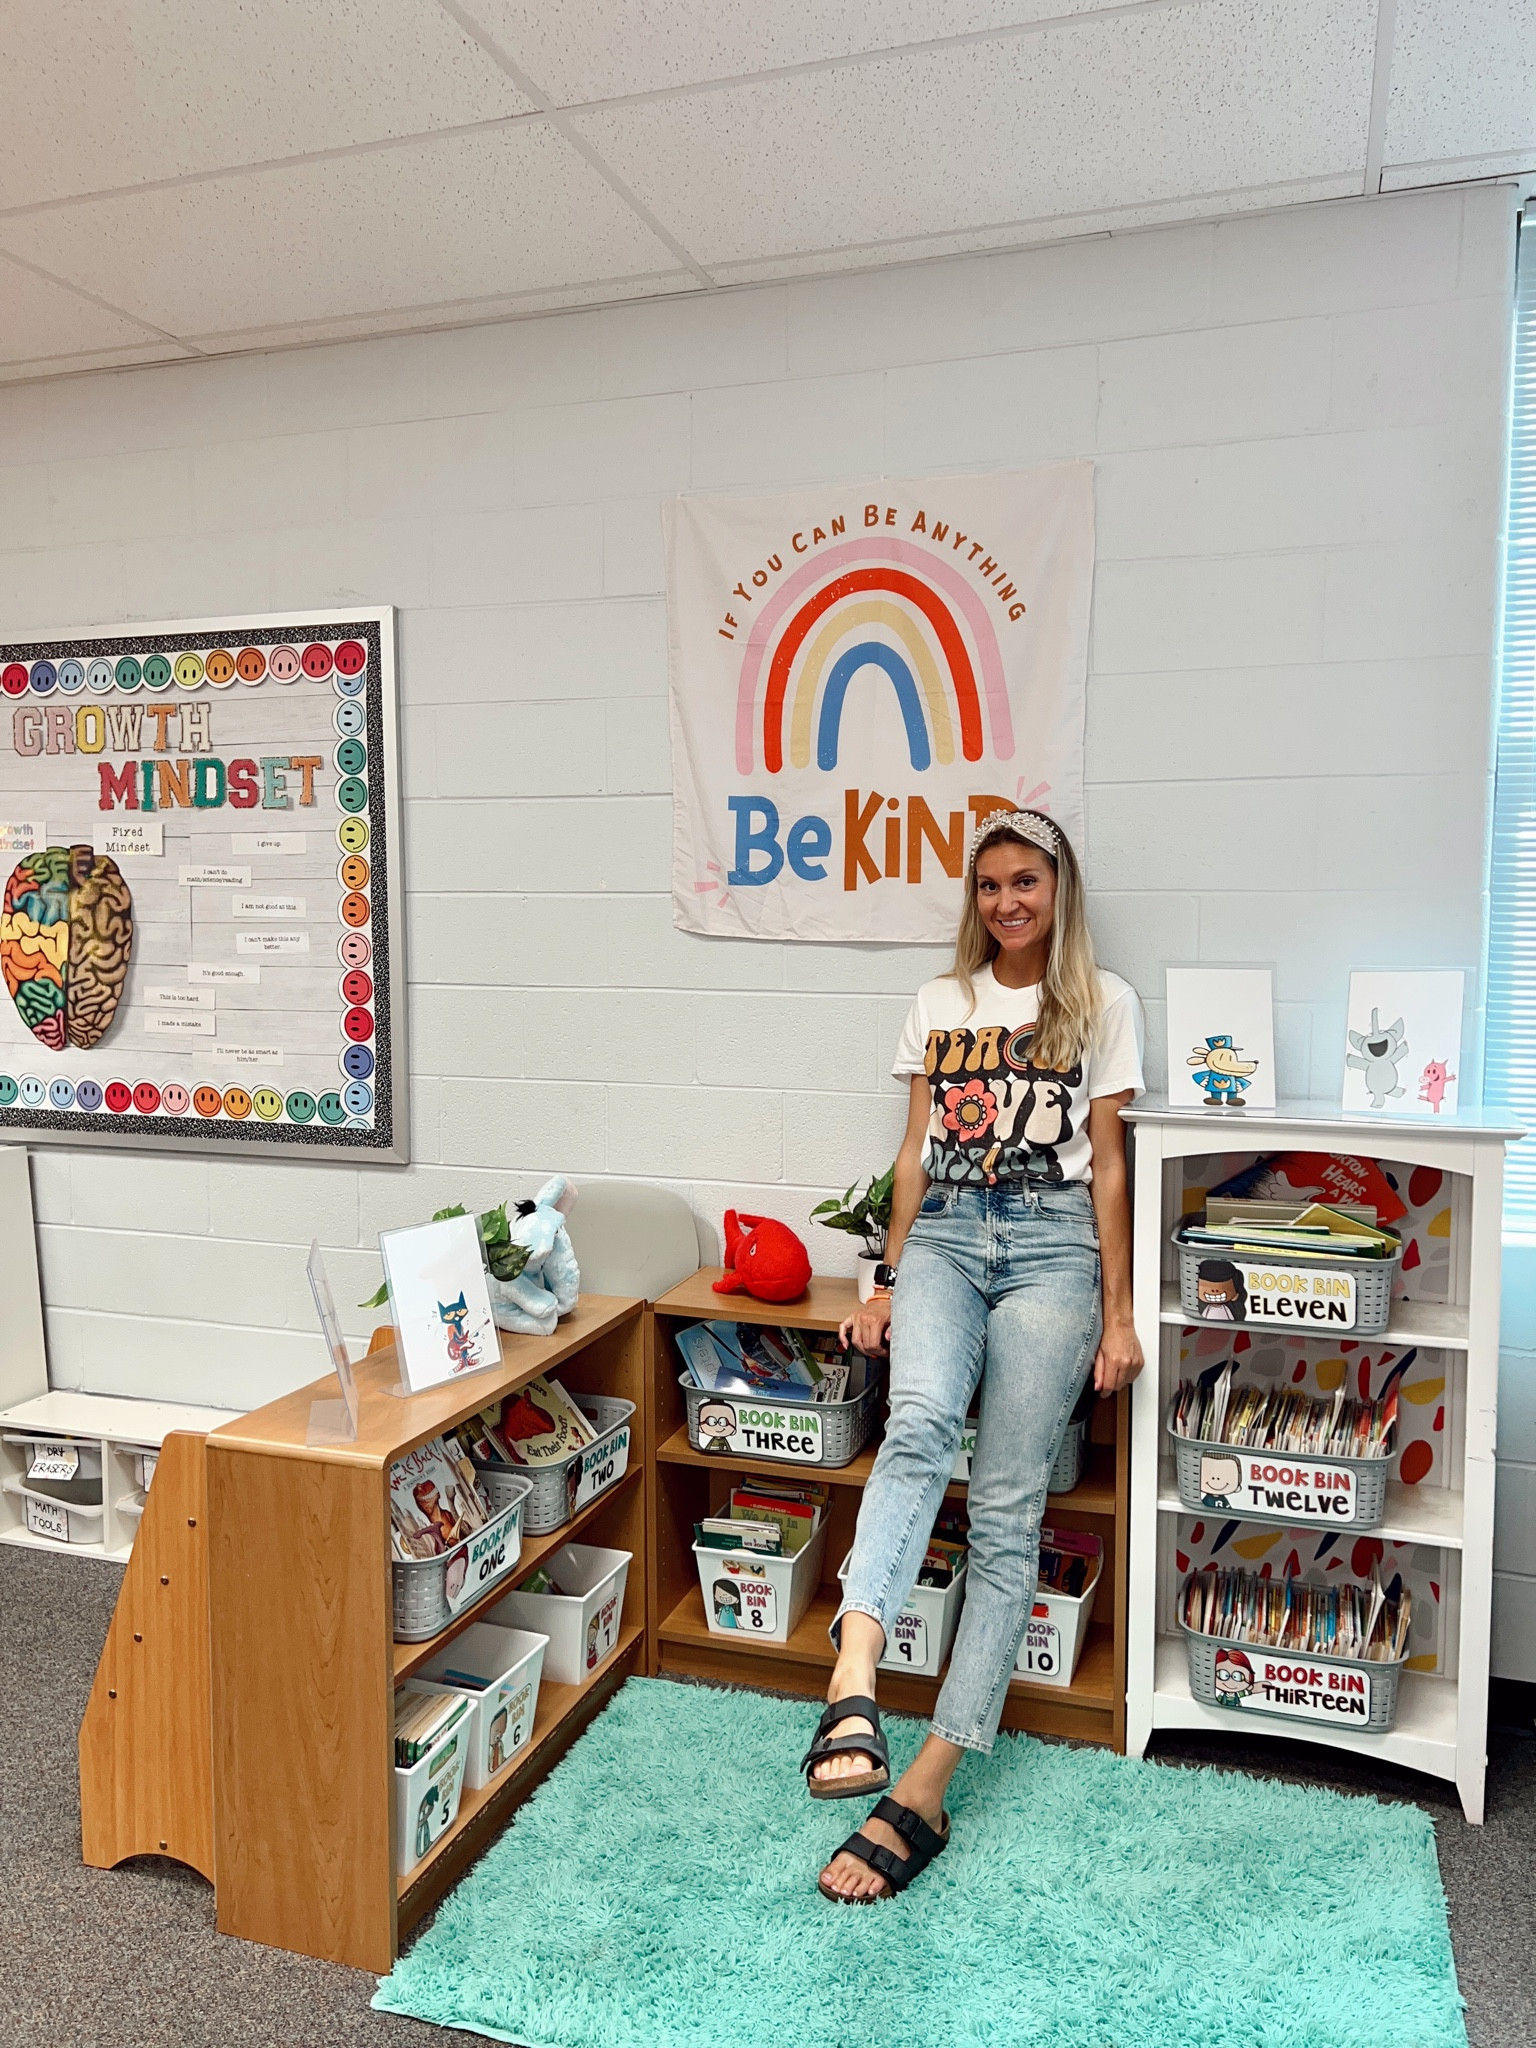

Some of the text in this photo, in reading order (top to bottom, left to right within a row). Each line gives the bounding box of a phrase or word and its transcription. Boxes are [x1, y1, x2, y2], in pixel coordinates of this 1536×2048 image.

[718, 504, 1027, 641] IF YOU CAN BE ANYTHING
[13, 702, 211, 756] GROWTH
[98, 755, 322, 812] MINDSET
[112, 826, 143, 837] Fixed
[728, 788, 1019, 892] Be KiN
[105, 842, 150, 852] Mindset
[924, 1022, 1071, 1077] TEAC
[1320, 1163, 1367, 1197] HEARS
[1328, 1188, 1340, 1198] A
[1248, 1272, 1308, 1293] BOOK
[739, 1409, 786, 1429] BOOK
[47, 1446, 65, 1457] DRY
[526, 1444, 543, 1458] Eat
[540, 1440, 562, 1457] Their
[584, 1444, 609, 1474] BOOK
[32, 1462, 75, 1474] ERASERS
[592, 1460, 614, 1490] TWO
[1250, 1464, 1309, 1486] BOOK
[35, 1502, 58, 1516] MATH
[33, 1515, 62, 1533] TOOLS
[471, 1527, 502, 1564] BOOK
[740, 1582, 772, 1596] BOOK
[751, 1609, 763, 1628] 8
[896, 1615, 922, 1628] OOK
[1027, 1622, 1055, 1637] OOK
[899, 1642, 912, 1662] 9
[1027, 1650, 1053, 1671] 10
[1264, 1663, 1324, 1687] BOOK
[513, 1724, 521, 1745] 6
[441, 1799, 450, 1825] 5
